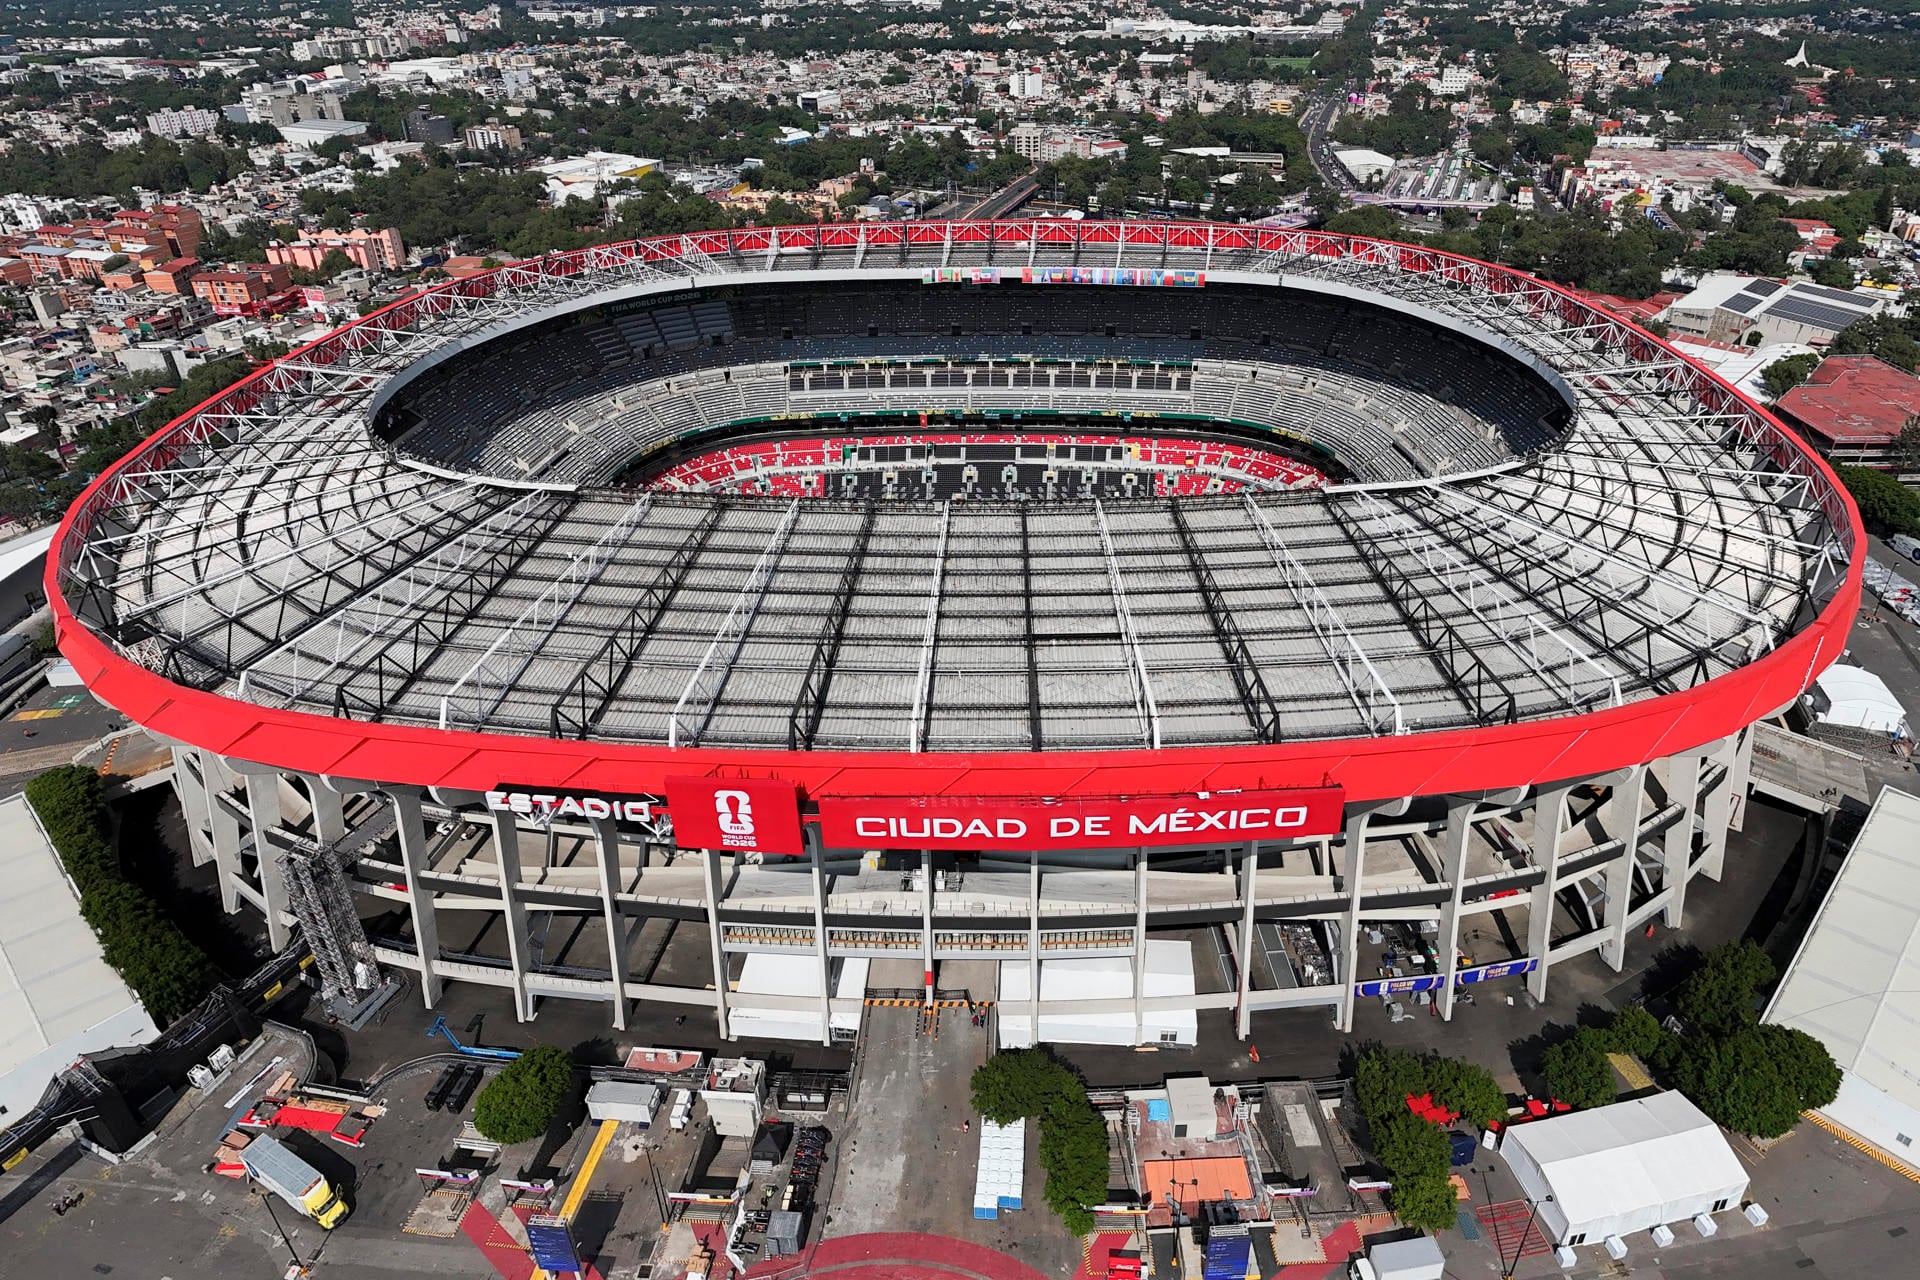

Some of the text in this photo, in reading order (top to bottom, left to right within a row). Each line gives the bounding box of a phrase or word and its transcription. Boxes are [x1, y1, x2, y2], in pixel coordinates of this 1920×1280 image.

[611, 292, 701, 313] FIFA WORLD CUP 2026
[485, 791, 650, 822] ESTADIO
[856, 806, 1308, 838] CIUDAD DE MÉXICO
[722, 839, 757, 847] 2026
